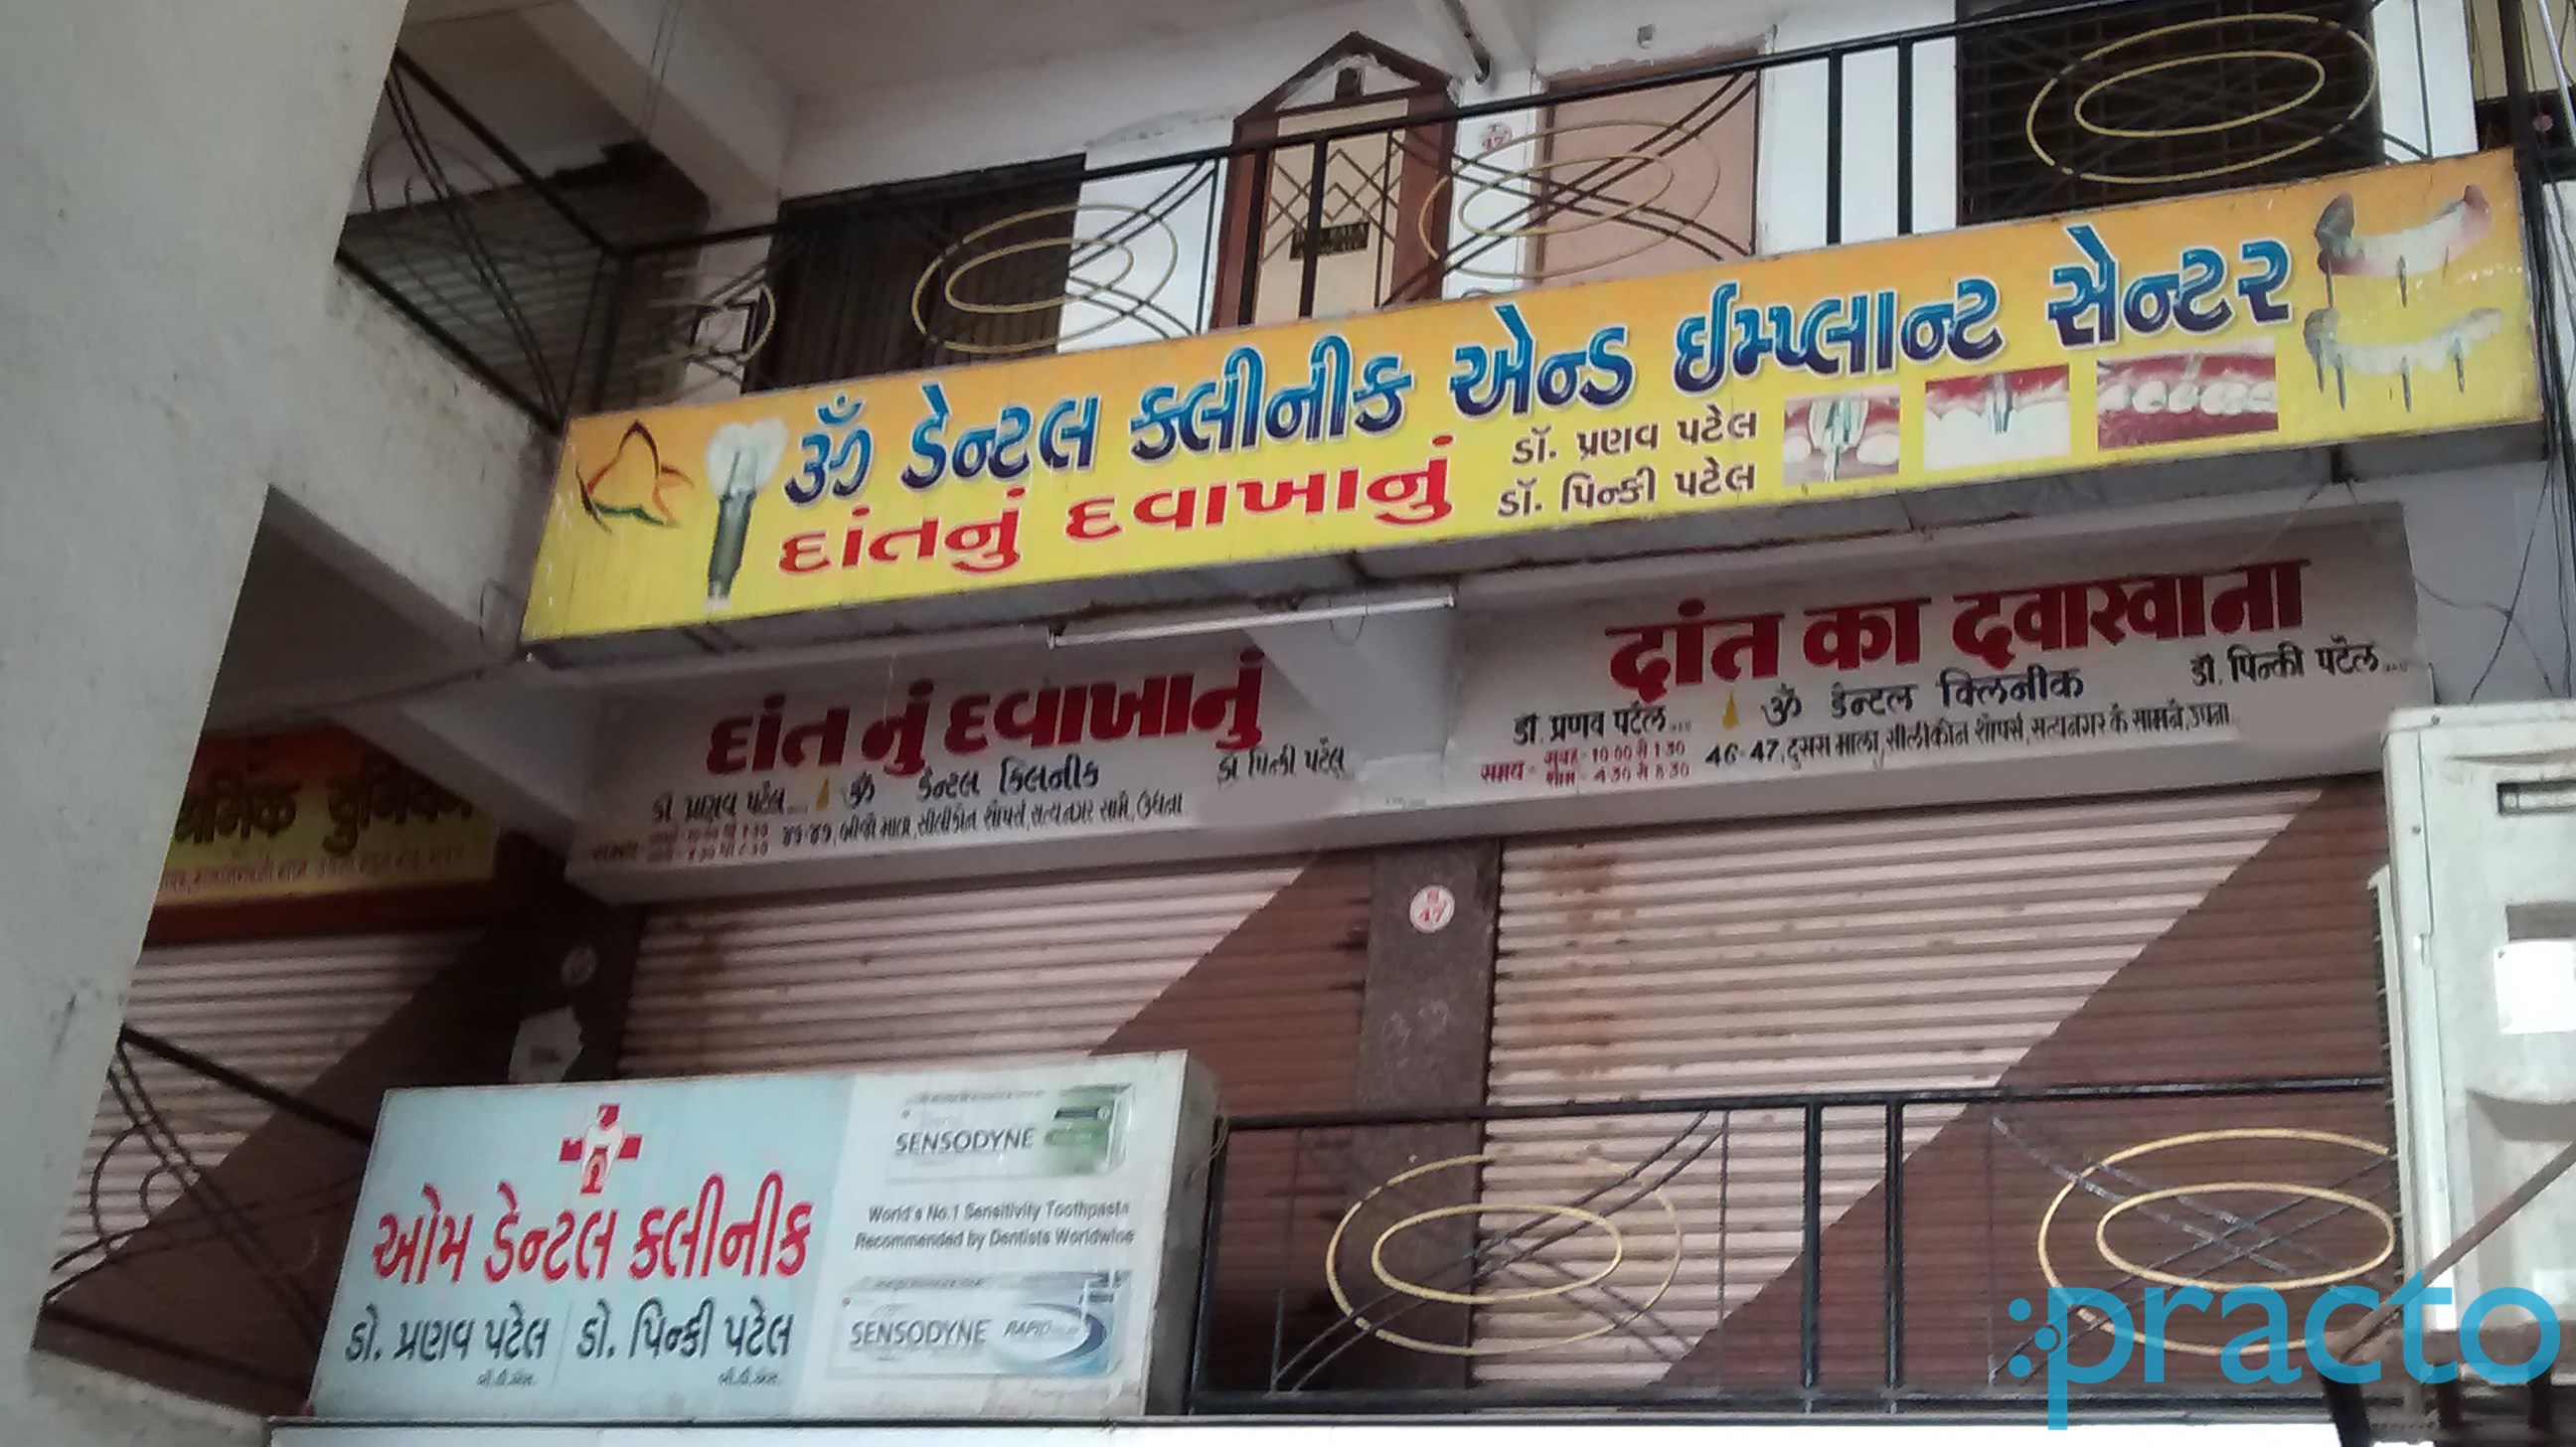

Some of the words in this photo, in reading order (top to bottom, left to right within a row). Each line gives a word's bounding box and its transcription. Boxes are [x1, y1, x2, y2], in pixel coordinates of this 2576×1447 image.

[899, 382, 1101, 491] ડેન્ટલ
[1449, 302, 1636, 418] એન્ડ
[1673, 280, 2003, 395] ઈમ્પ્લાન્ટ
[2047, 224, 2292, 348] સેન્ટર
[1576, 422, 1659, 460] પ્રણવ
[1677, 402, 1758, 445] પટેલ
[778, 486, 1026, 576] દાંતનું
[1064, 434, 1456, 542] દવાખાનું
[1561, 466, 1655, 513] પિન્કી
[1674, 456, 1756, 500] પટેલ
[1603, 598, 1786, 704] दांत
[1803, 596, 1932, 671] का
[1951, 558, 2311, 670] दवाखाना
[2315, 634, 2379, 677] पटेल
[943, 646, 1265, 755] દવાખાનું
[895, 1127, 1038, 1157] SENSODYNE
[371, 1182, 475, 1286] ઓમ
[483, 1180, 619, 1285] ડેન્ટલ
[854, 1229, 964, 1251] Recommended
[967, 1228, 987, 1252] by
[989, 1227, 1050, 1248] Dentists
[964, 1200, 1042, 1223] Sensitivity
[1046, 1200, 1130, 1221] Toothpaste
[393, 1316, 476, 1364] પ્રણવ
[484, 1299, 553, 1364] પટેલ
[628, 1295, 717, 1360] પિન્કી
[724, 1295, 795, 1359] પટેલ
[849, 1317, 992, 1349] SENSODYNE
